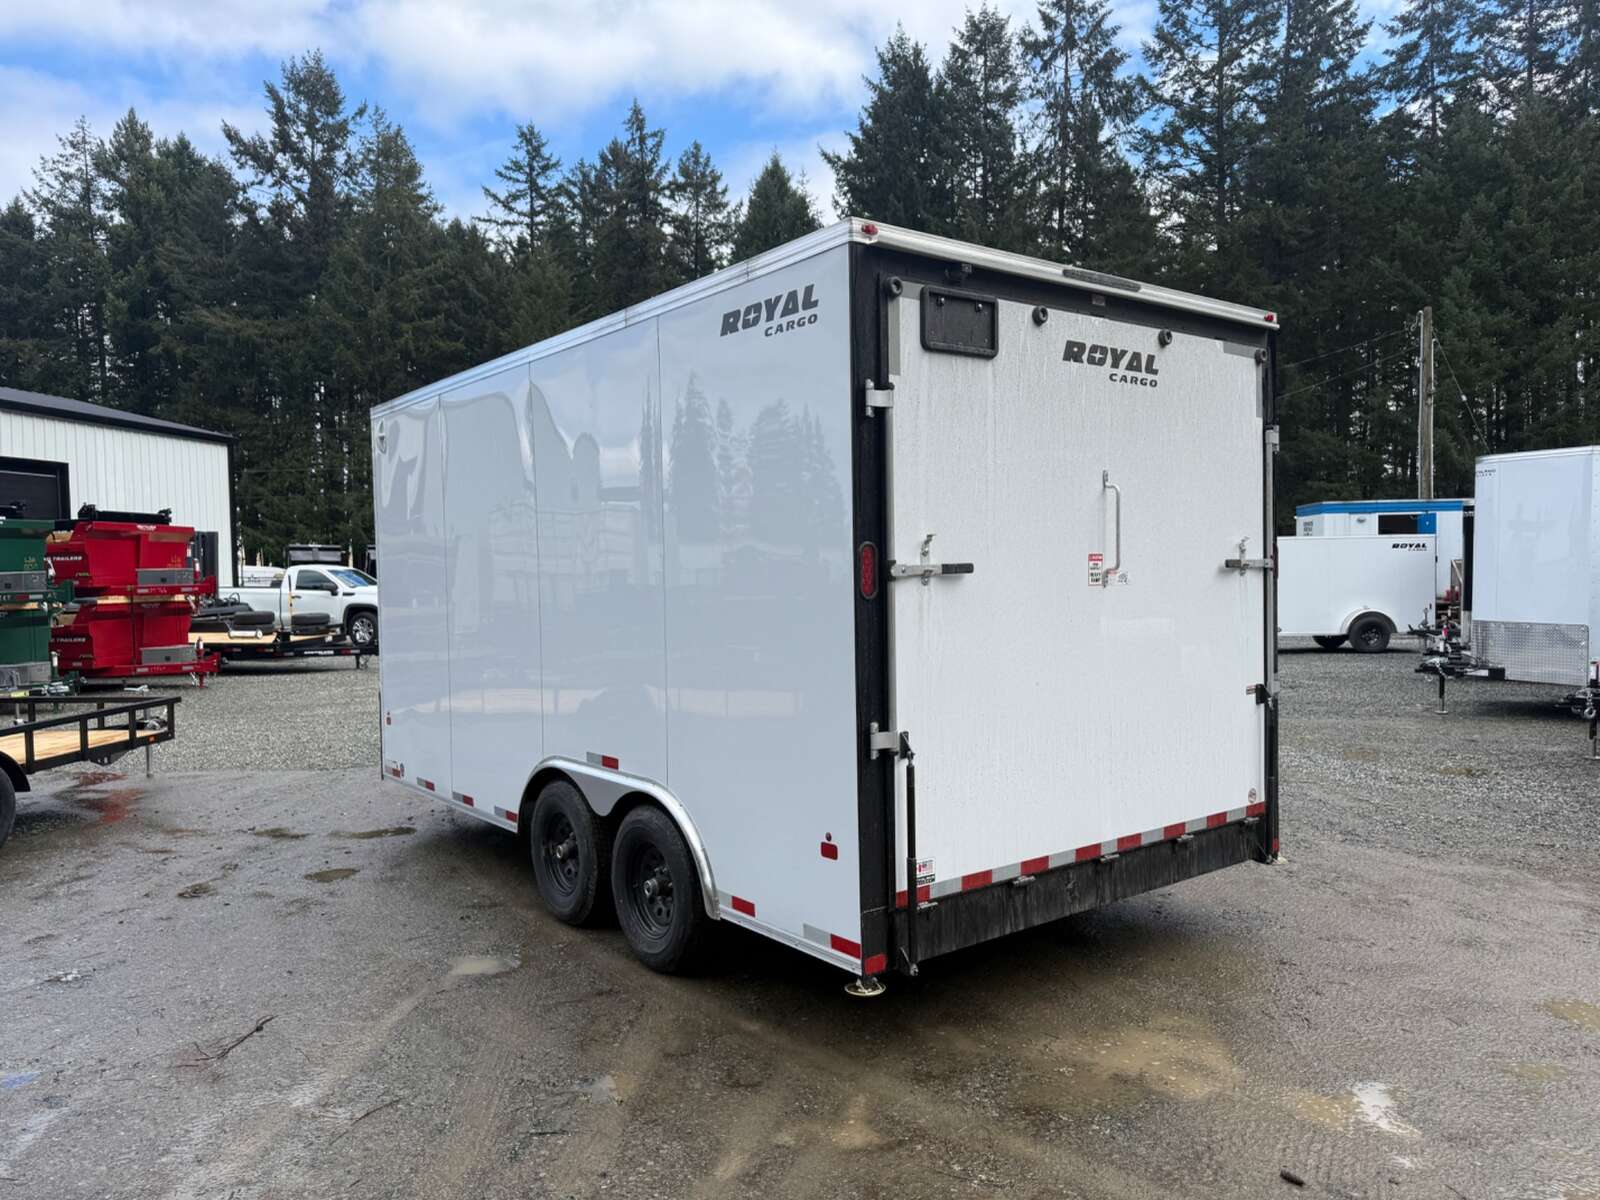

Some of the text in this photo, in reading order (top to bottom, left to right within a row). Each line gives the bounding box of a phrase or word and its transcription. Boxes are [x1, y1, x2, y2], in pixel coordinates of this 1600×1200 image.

[720, 283, 819, 337] ROYAL
[764, 313, 818, 338] CARGO
[1062, 339, 1159, 376] ROYAL
[1108, 373, 1158, 388] CARGO
[1391, 542, 1427, 550] ROYAL
